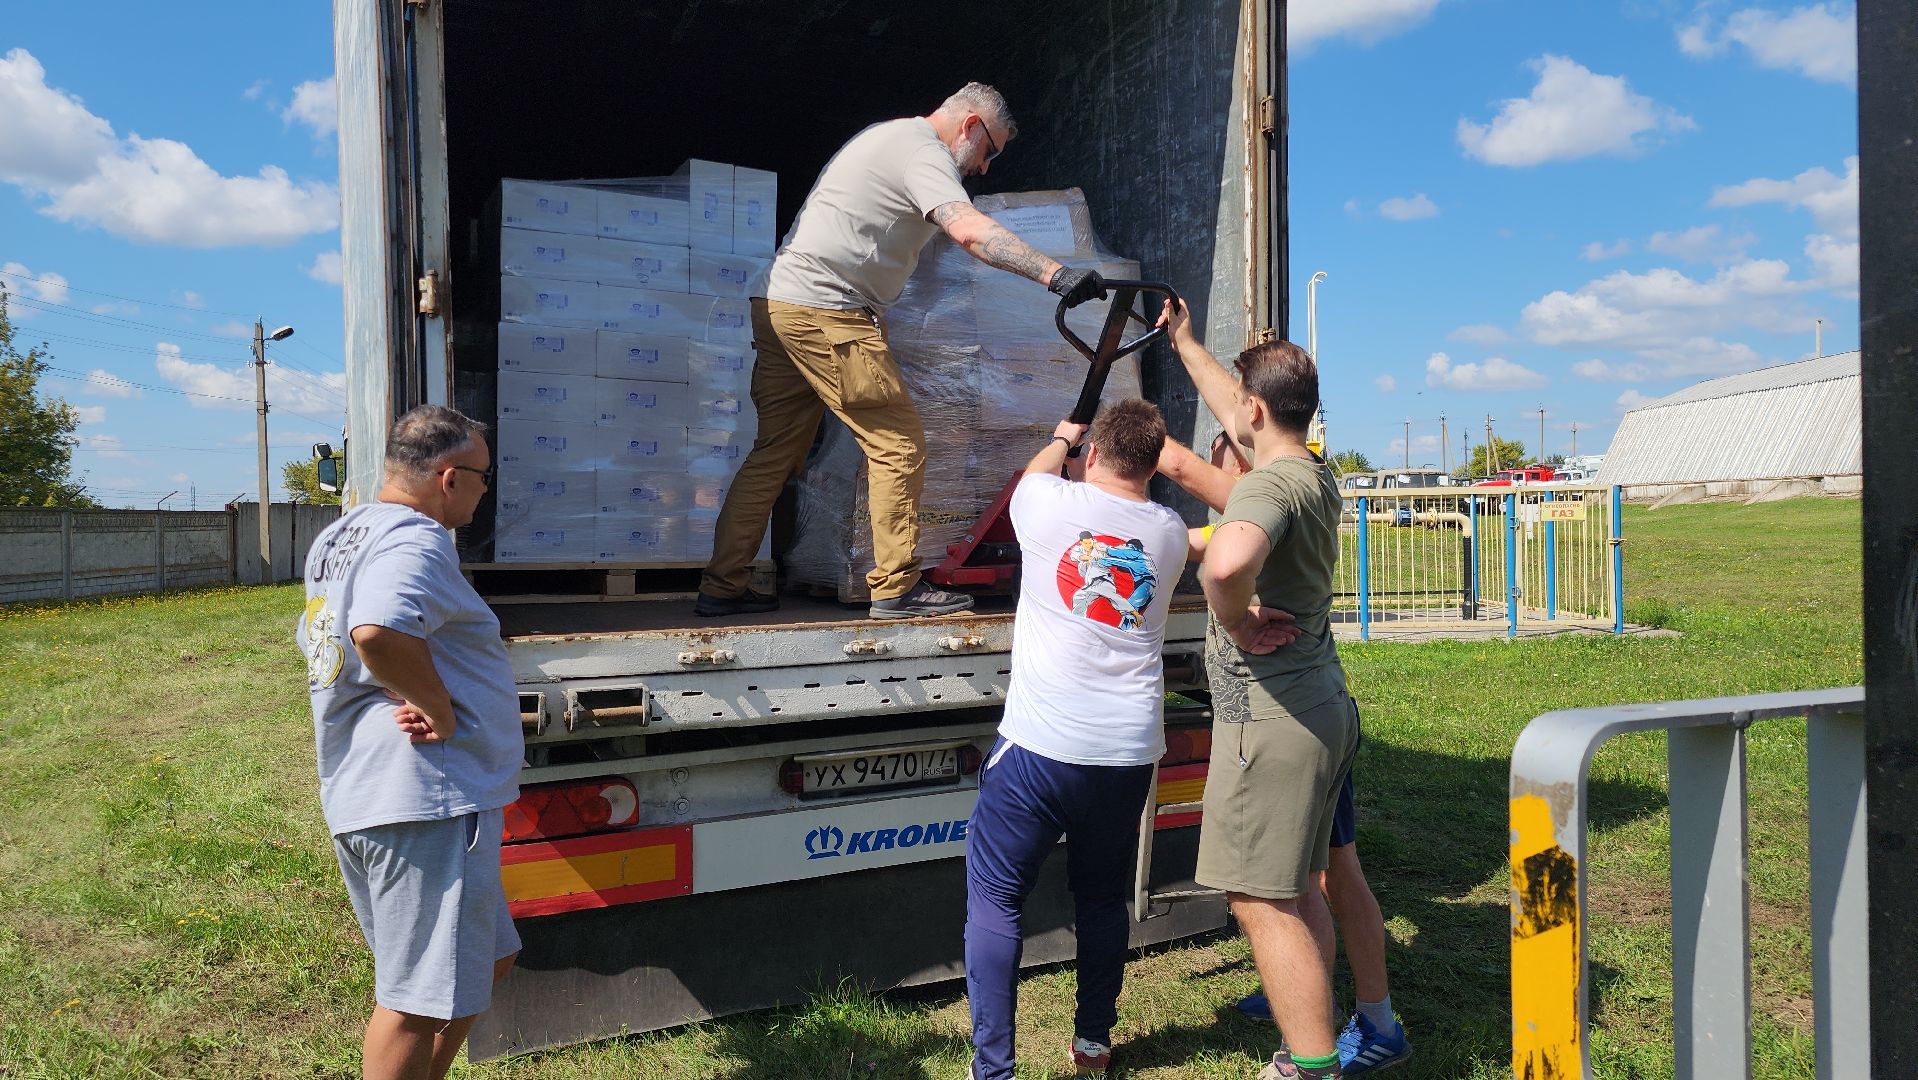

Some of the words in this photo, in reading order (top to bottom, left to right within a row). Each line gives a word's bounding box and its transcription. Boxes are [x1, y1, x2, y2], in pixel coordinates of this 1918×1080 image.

[1551, 509, 1575, 518] ГАЗ
[853, 752, 917, 783] 9470
[923, 767, 942, 776] RUS
[846, 819, 969, 856] KRONE
